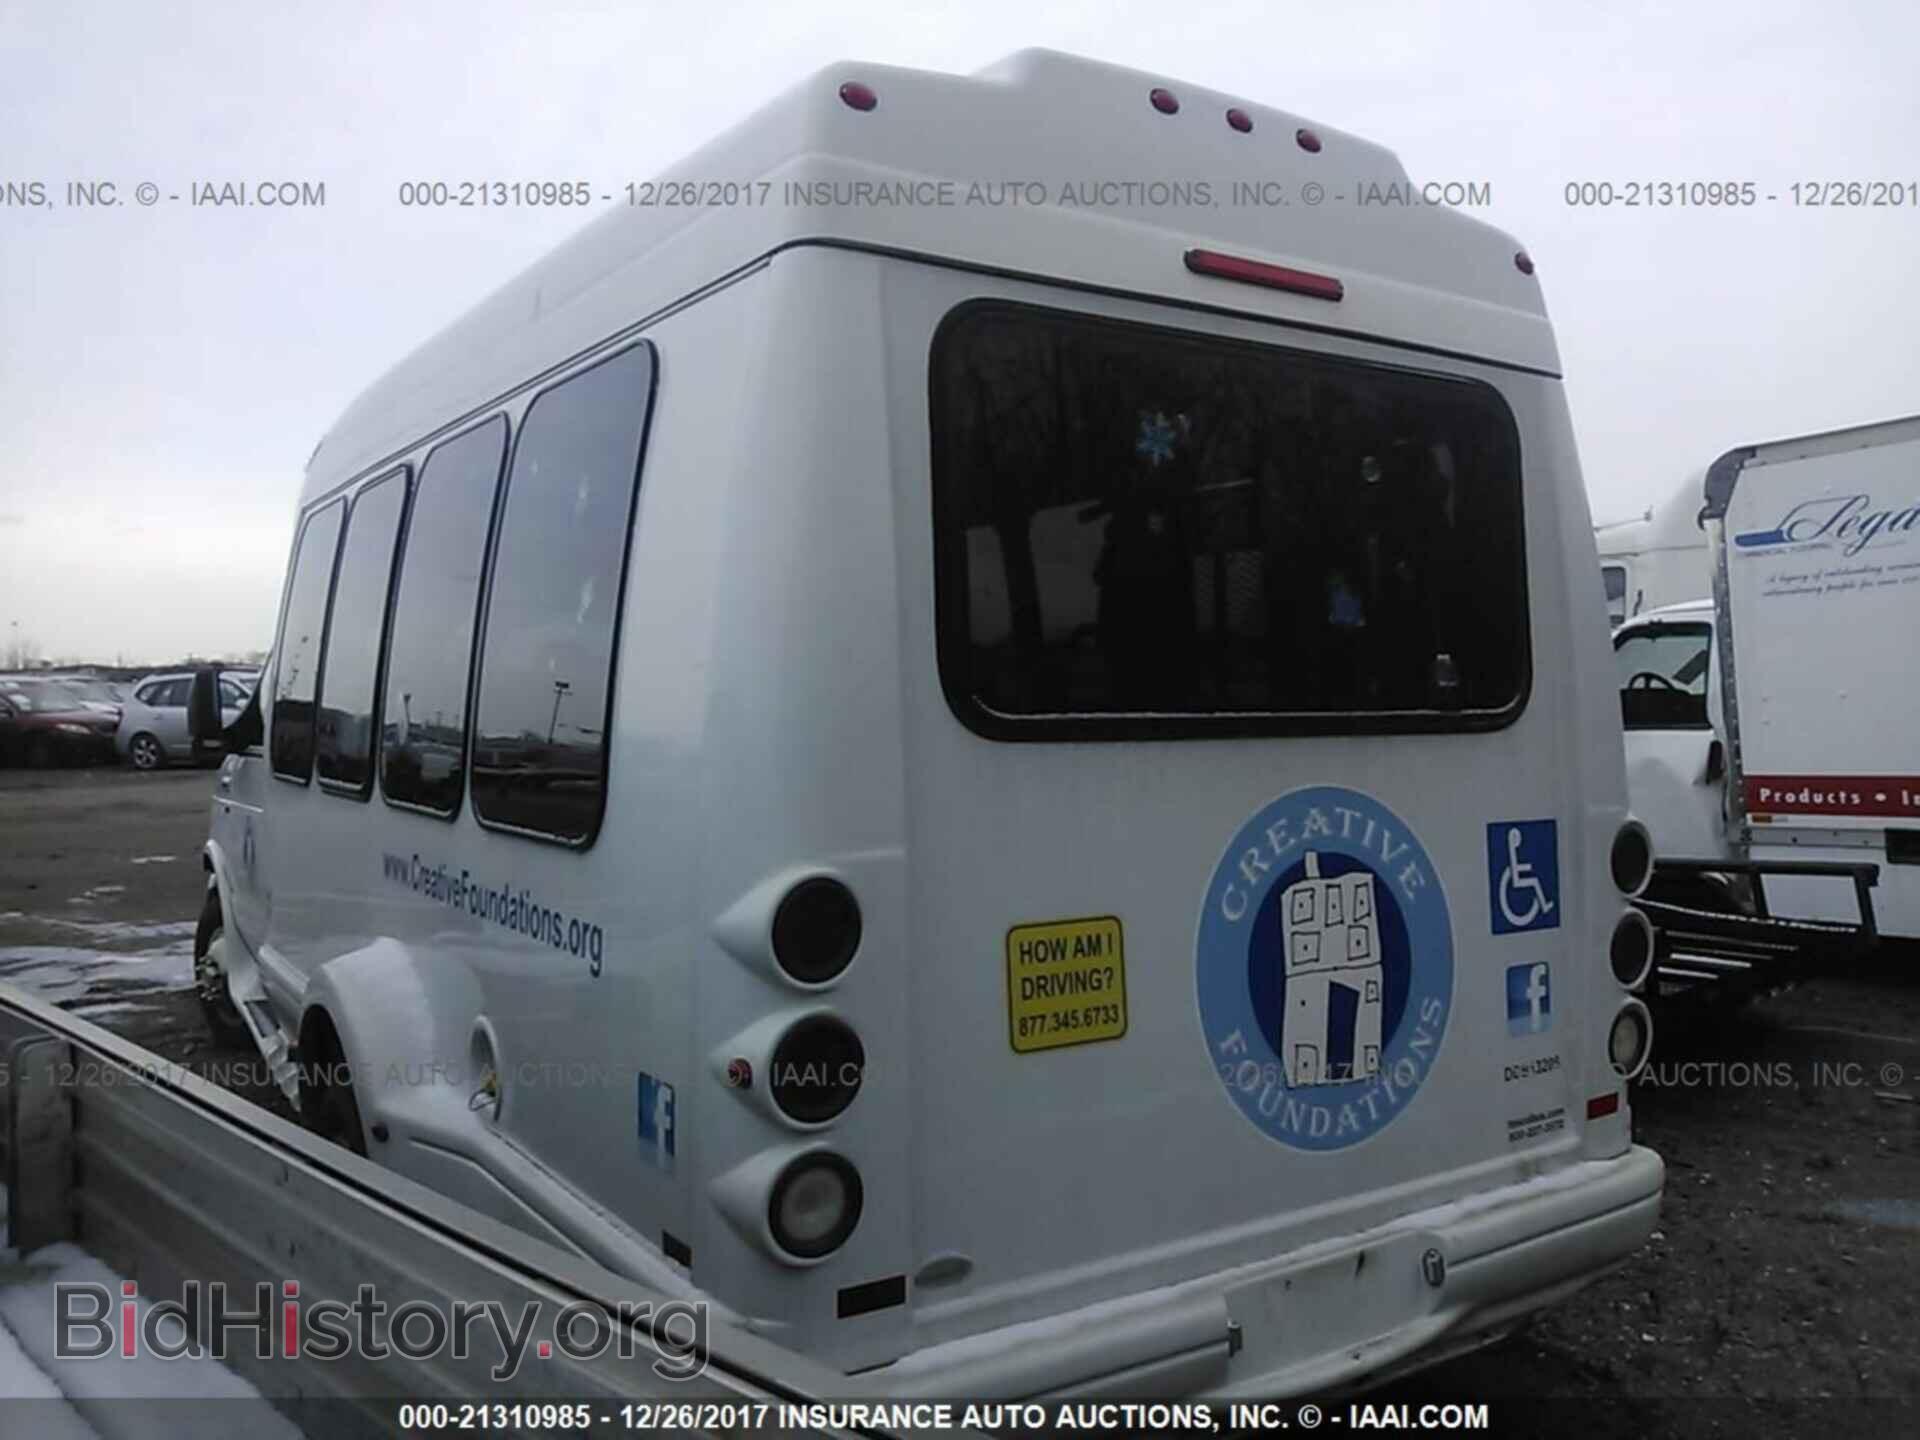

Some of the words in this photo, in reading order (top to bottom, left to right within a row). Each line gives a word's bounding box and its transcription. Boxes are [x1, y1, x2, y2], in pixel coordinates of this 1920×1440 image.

[1759, 787, 1861, 805] Products
[1221, 806, 1425, 922] CREATIVE
[382, 852, 604, 978] www.CreativeFoundations.org
[1019, 936, 1067, 965] HOW
[1072, 933, 1102, 959] AM
[1107, 932, 1113, 955] I
[1021, 966, 1114, 1001] DRIVING?
[1018, 1003, 1120, 1037] 877.345.6733
[1220, 997, 1442, 1138] FOUNDATIONS
